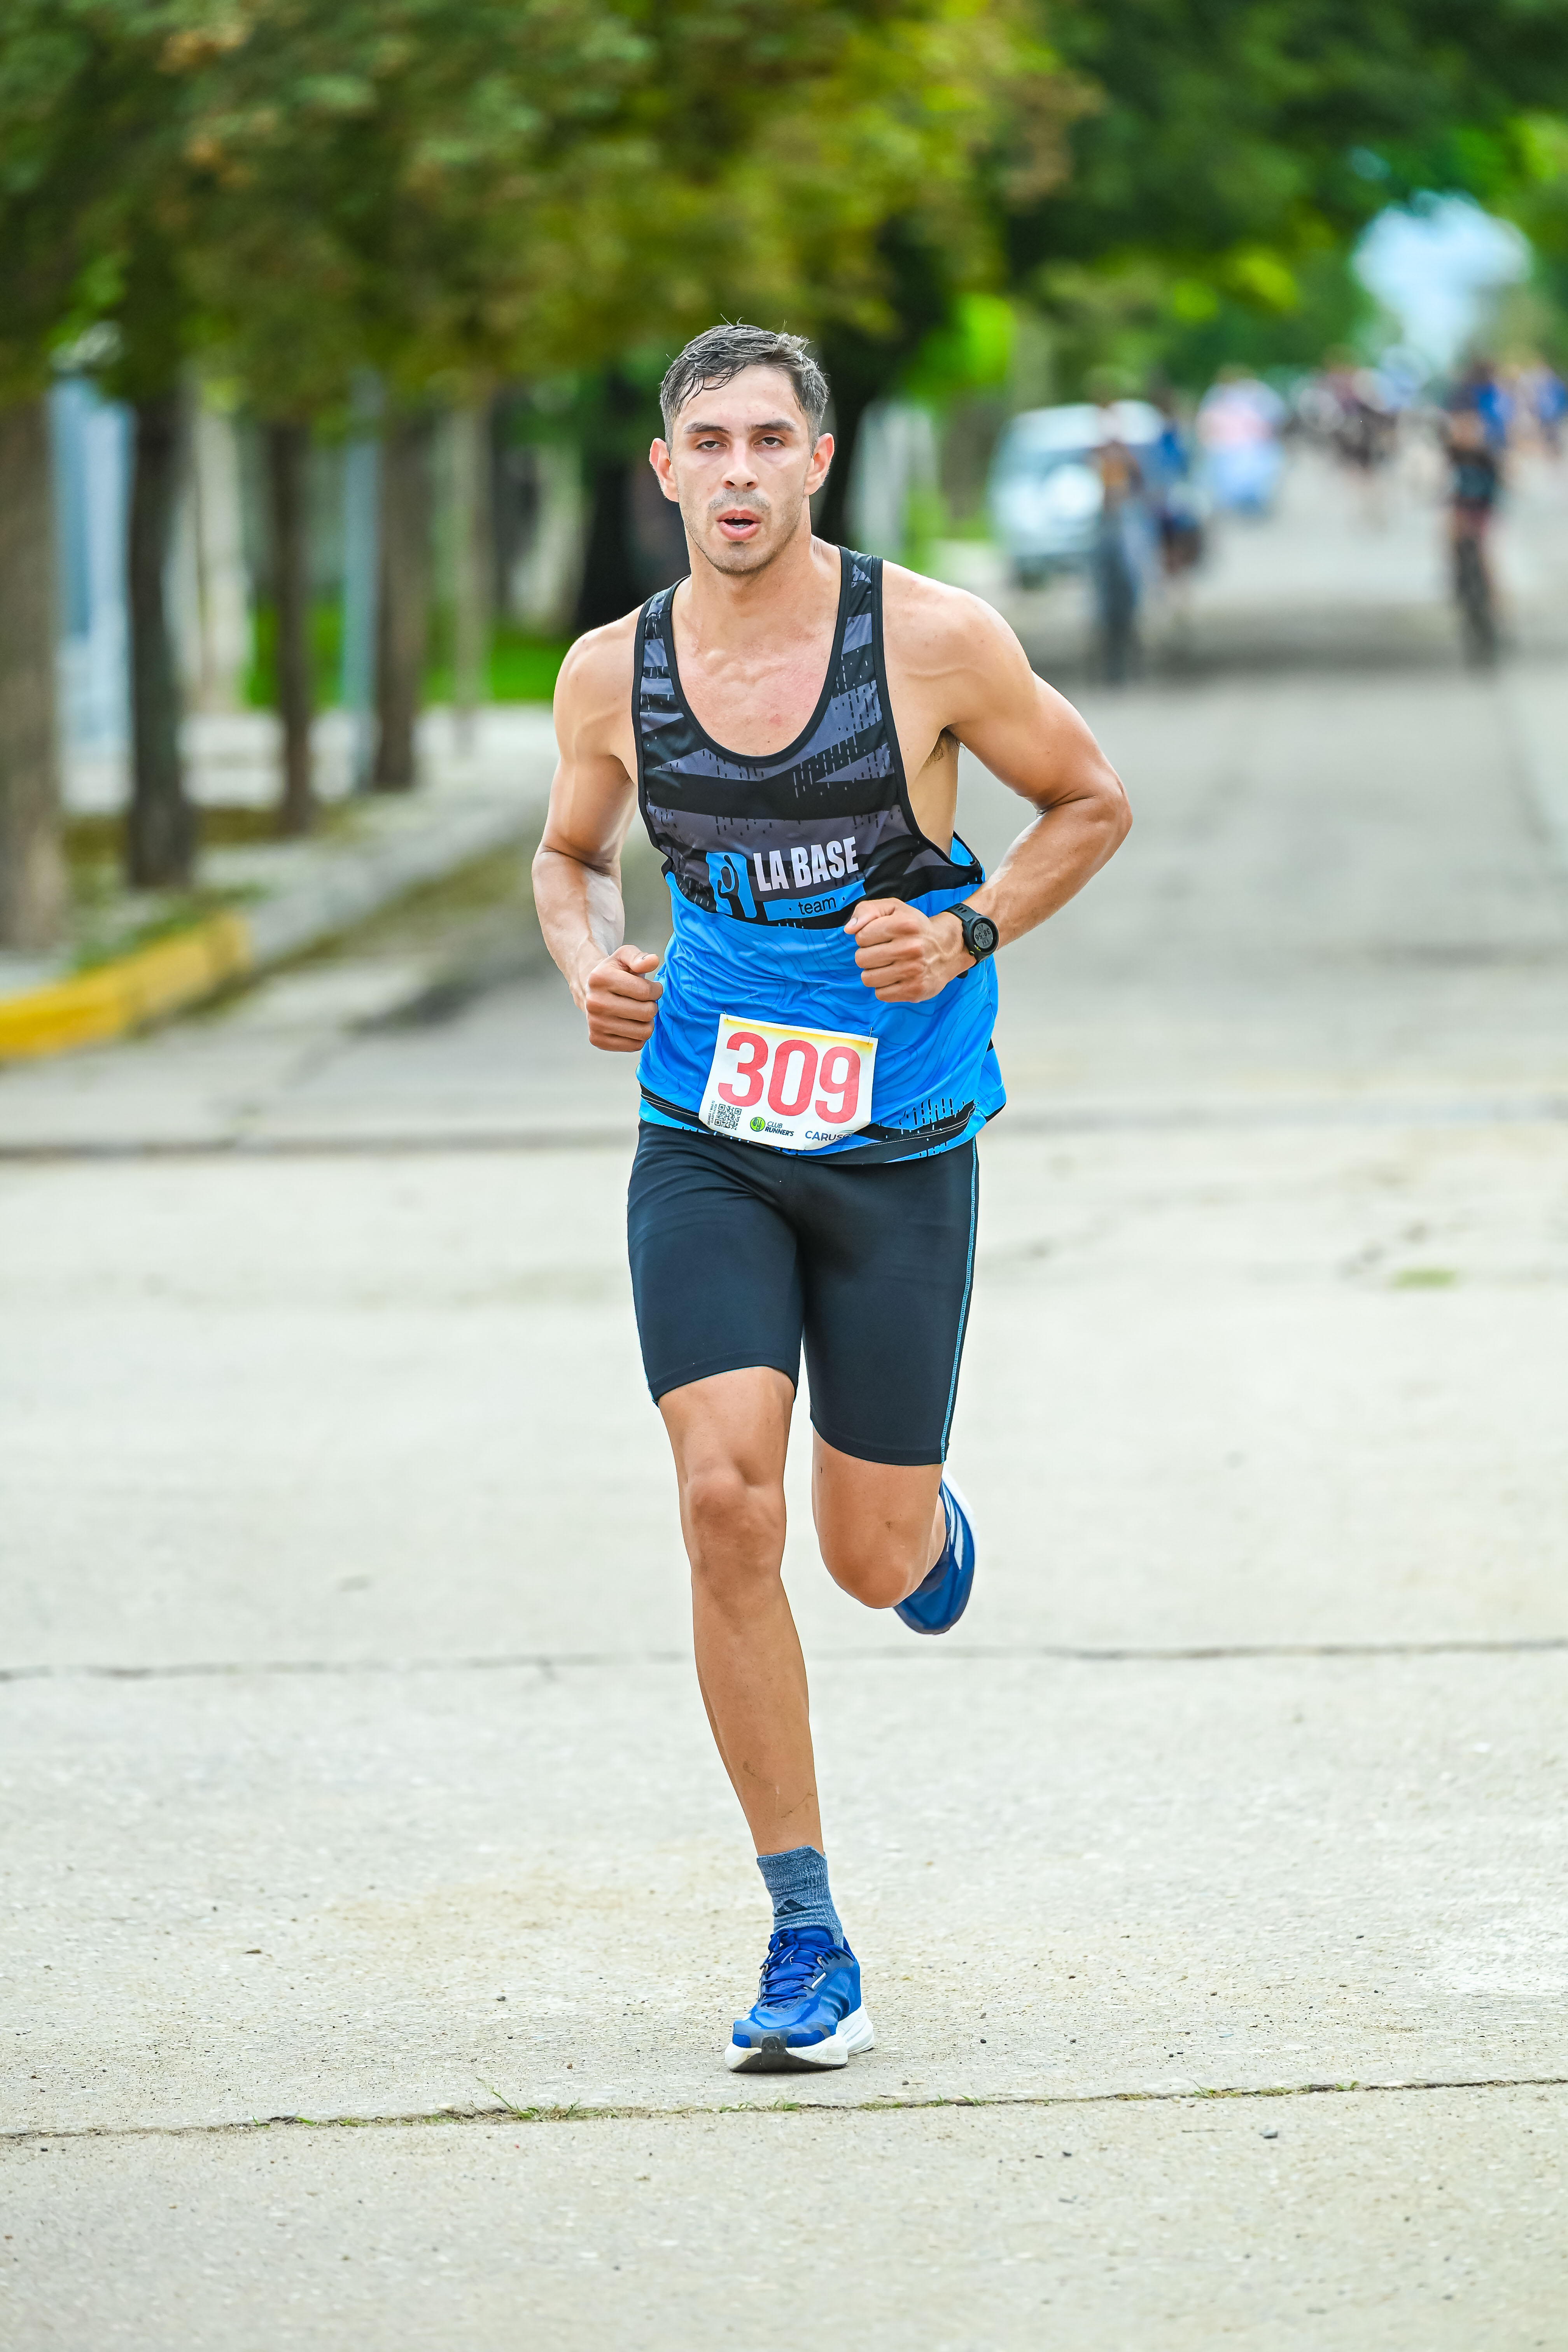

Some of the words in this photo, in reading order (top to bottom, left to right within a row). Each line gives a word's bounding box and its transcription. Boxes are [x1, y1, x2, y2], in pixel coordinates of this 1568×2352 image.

[753, 850, 789, 892] LA
[790, 836, 859, 888] BASE
[798, 896, 836, 915] team
[718, 1032, 861, 1124] 309
[765, 1126, 794, 1137] RUNNER'S
